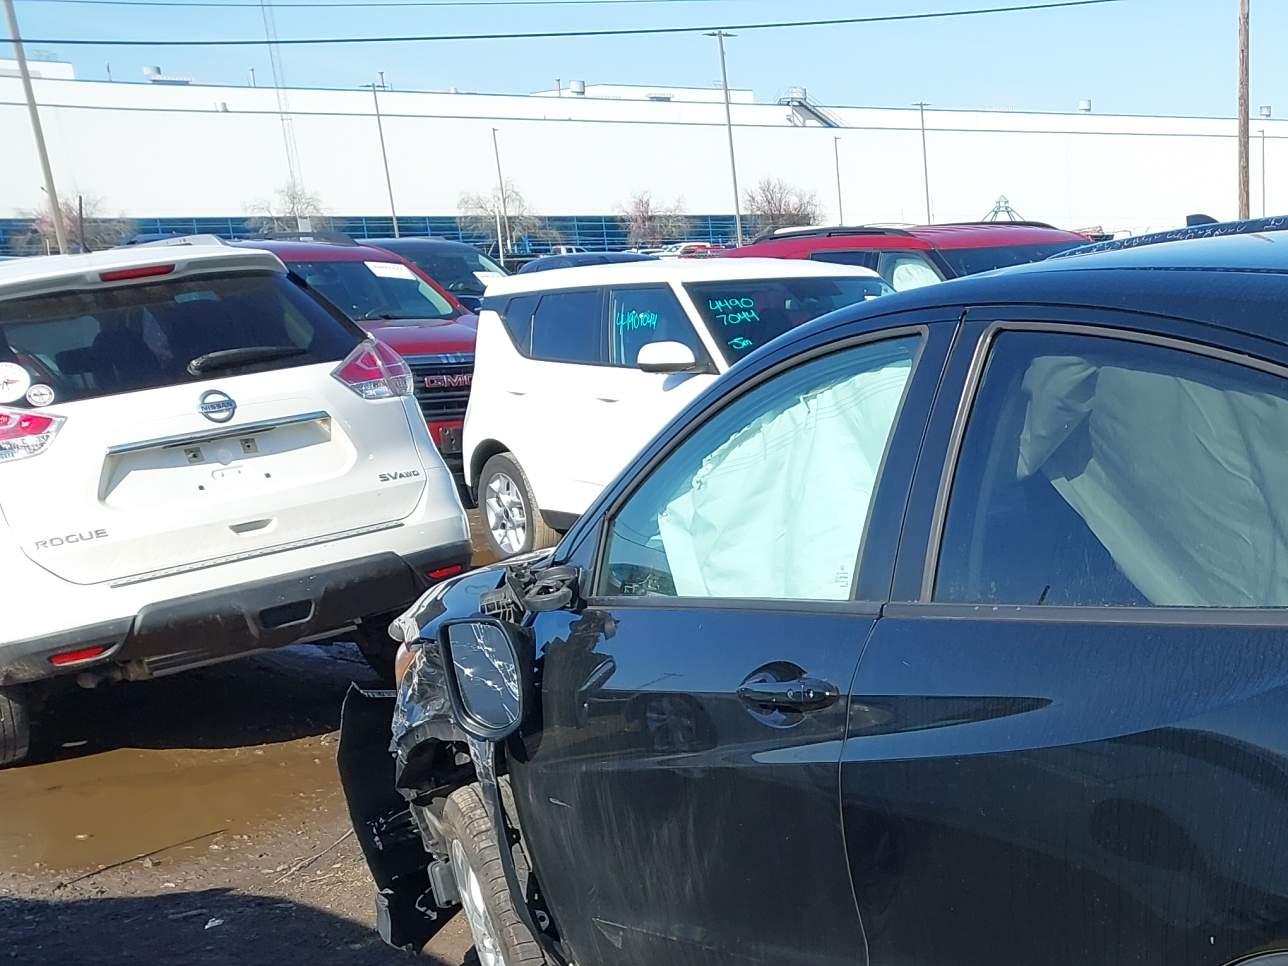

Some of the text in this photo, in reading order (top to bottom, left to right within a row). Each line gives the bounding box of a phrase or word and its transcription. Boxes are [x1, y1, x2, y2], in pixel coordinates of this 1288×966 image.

[709, 297, 754, 312] 4490
[716, 309, 760, 326] 7044
[32, 528, 109, 551] ROGUE
